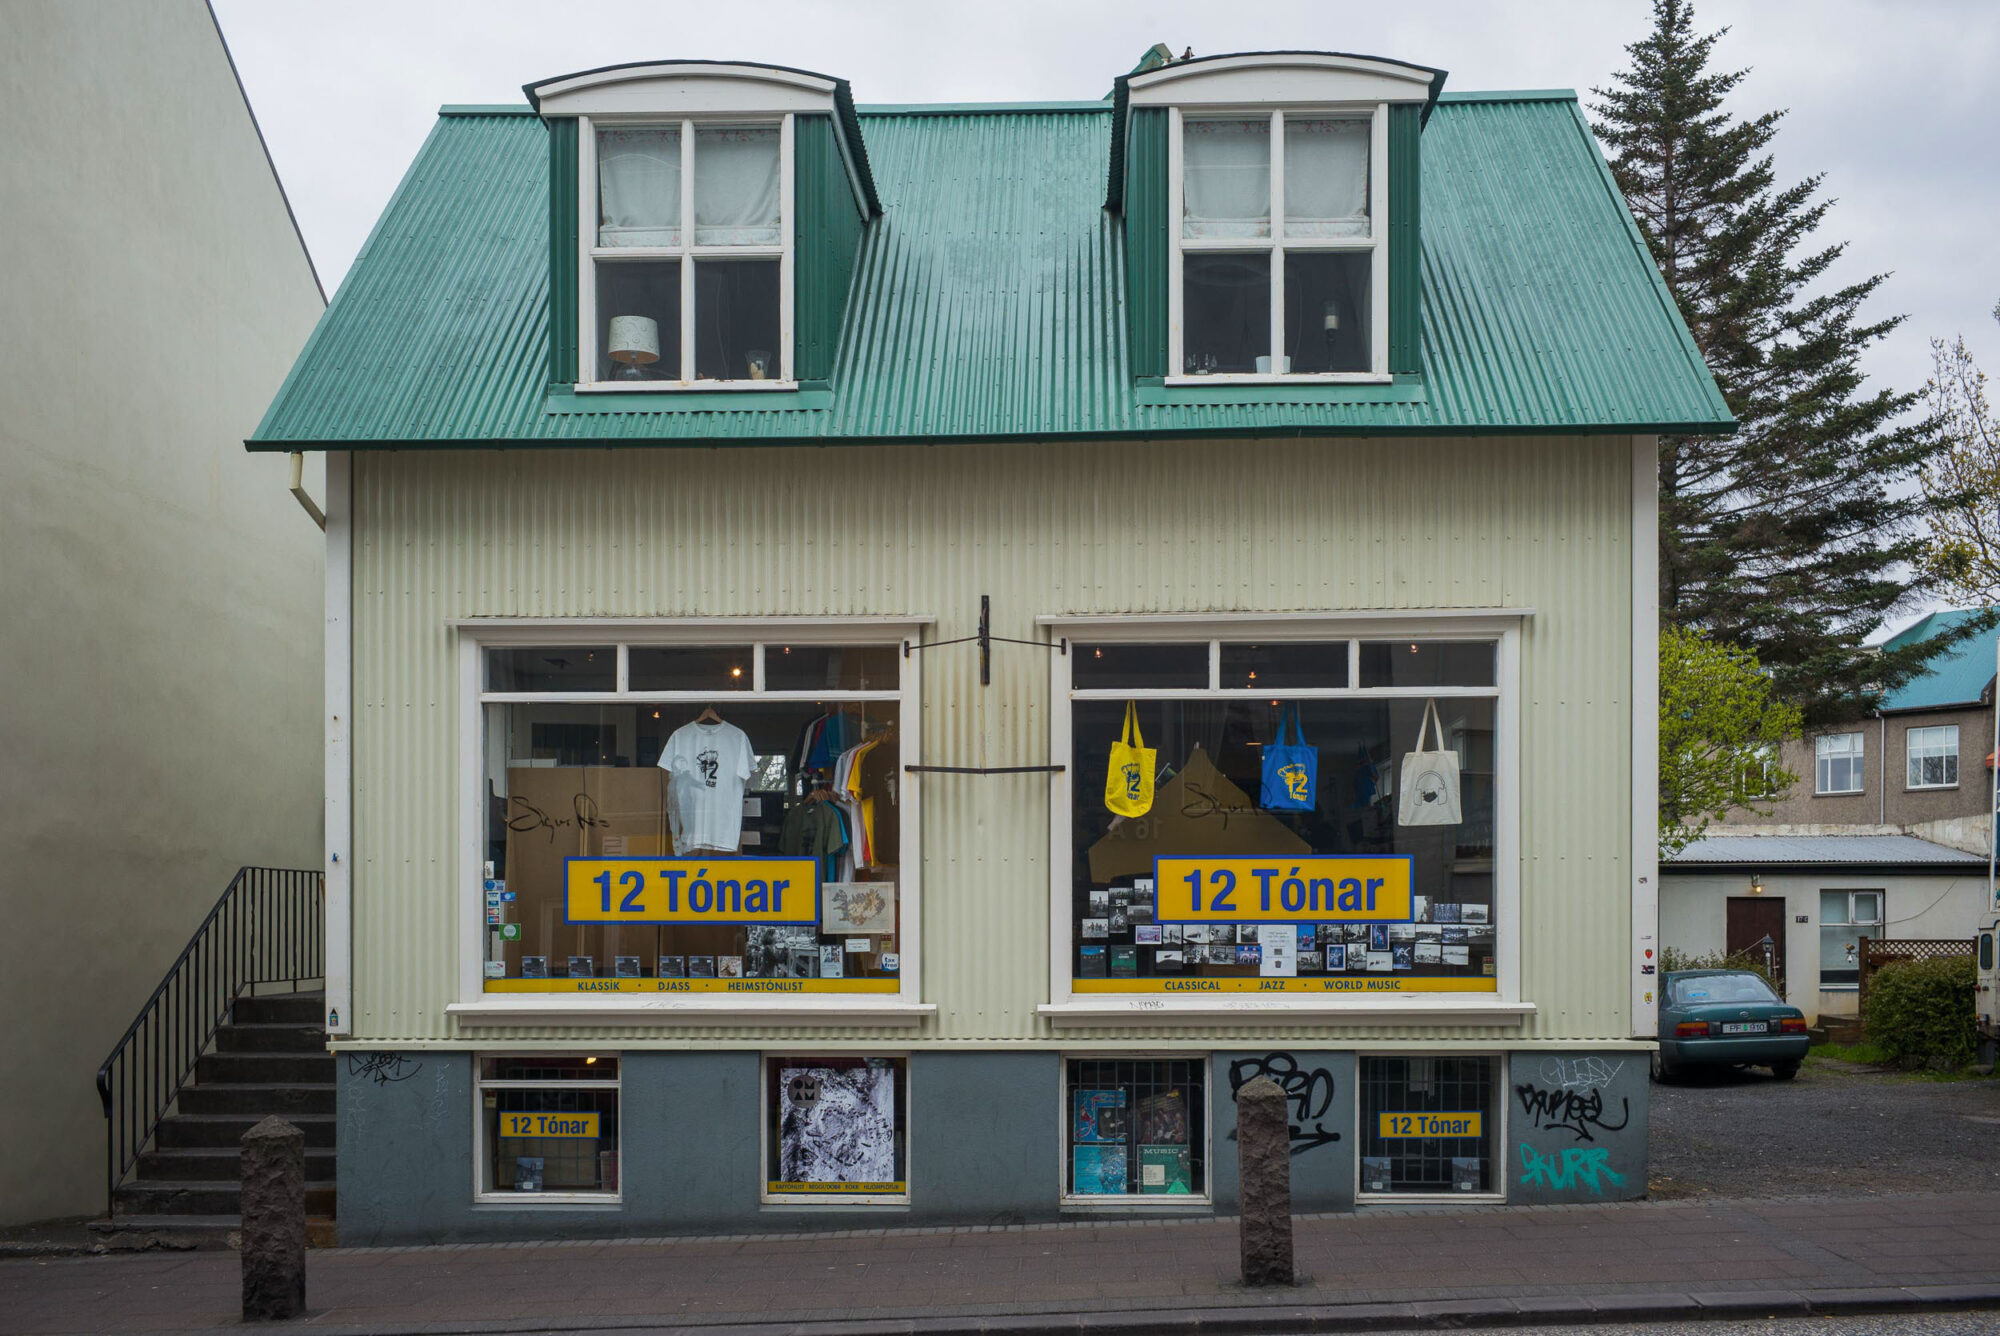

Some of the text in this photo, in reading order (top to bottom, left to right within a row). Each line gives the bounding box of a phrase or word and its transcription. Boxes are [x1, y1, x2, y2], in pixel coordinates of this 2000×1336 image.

[593, 868, 790, 913] 12 Tónar
[1183, 866, 1385, 912] 12 Tónar
[658, 981, 690, 991] DJASS
[728, 980, 803, 991] HEIMSTÓNLIST
[1164, 980, 1401, 991] CLASSICAL JAZZ WORLD MUSIC
[793, 1079, 815, 1090] OM
[794, 1091, 815, 1101] AM
[510, 1115, 589, 1134] 12 Tónar
[1390, 1115, 1471, 1134] 12 Tónar
